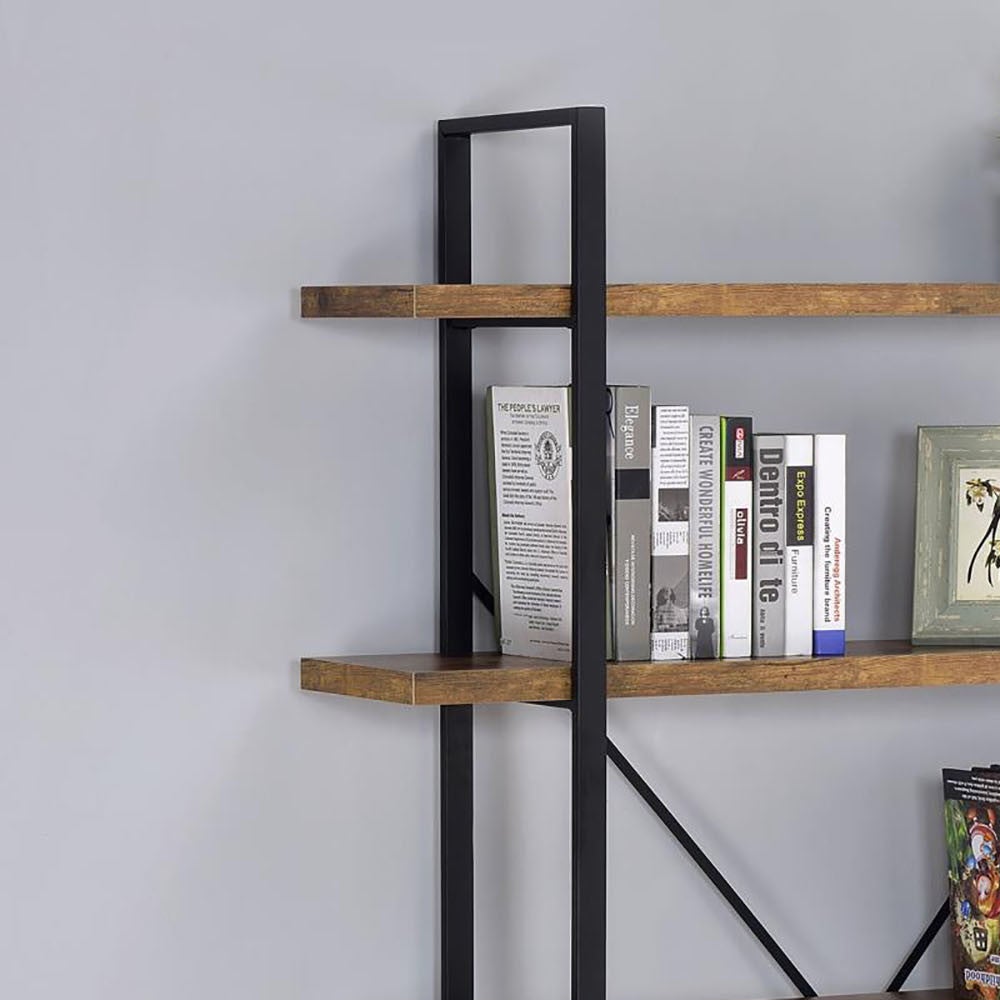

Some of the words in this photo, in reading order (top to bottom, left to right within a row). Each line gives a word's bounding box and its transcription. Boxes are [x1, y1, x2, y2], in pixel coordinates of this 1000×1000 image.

[498, 403, 509, 412] THE
[537, 404, 561, 413] LAWYER
[620, 404, 639, 460] Elegance
[698, 425, 714, 466] CREATE
[759, 448, 783, 539] Dentro
[794, 470, 806, 497] Expo
[698, 469, 714, 539] WONDERFUL
[795, 499, 806, 541] Express
[736, 511, 747, 545] olivia
[823, 506, 832, 543] Creating
[759, 542, 783, 565] di
[824, 544, 832, 558] the
[832, 537, 842, 578] Anderegg
[698, 543, 714, 599] HOMELIFE
[791, 549, 800, 594] Furniture
[824, 560, 832, 596] furniture
[759, 578, 783, 603] te
[824, 598, 832, 623] brand
